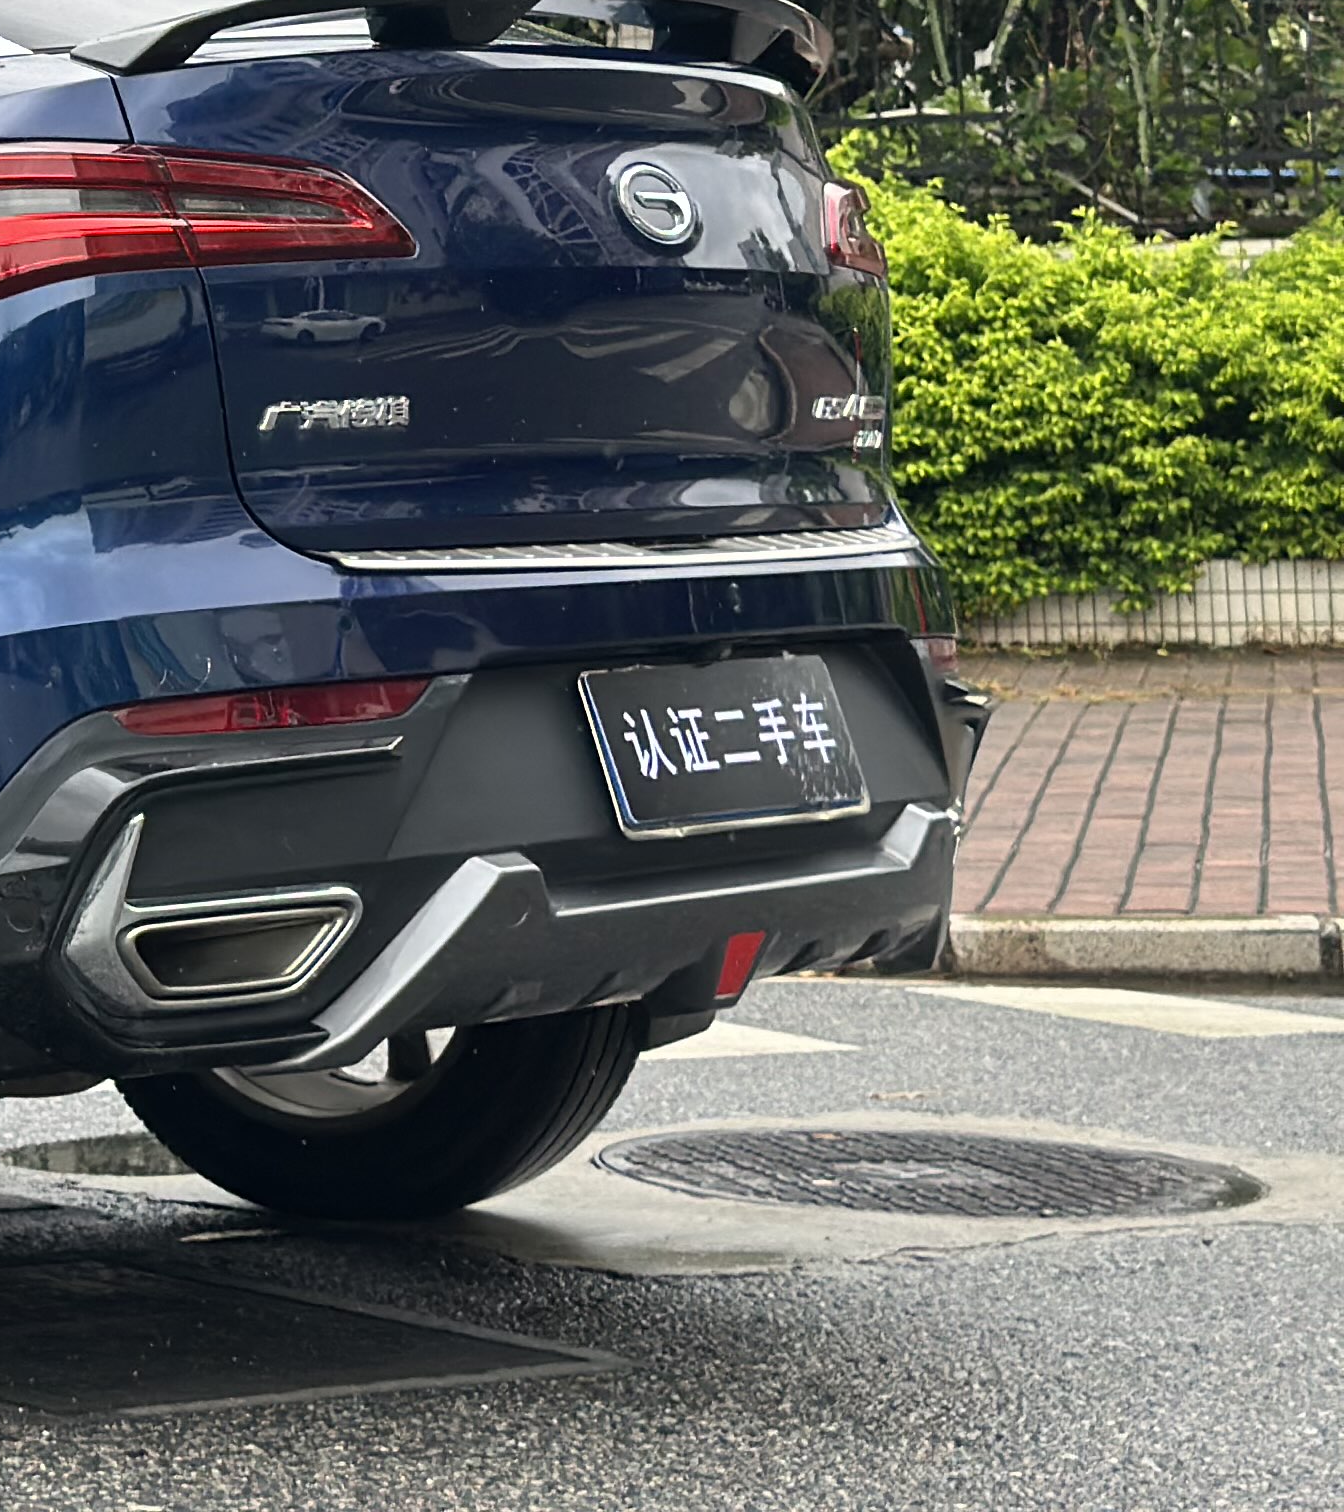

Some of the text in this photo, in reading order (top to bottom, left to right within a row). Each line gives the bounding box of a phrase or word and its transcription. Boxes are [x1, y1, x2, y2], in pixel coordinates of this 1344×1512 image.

[623, 692, 837, 780] 认证二手车
